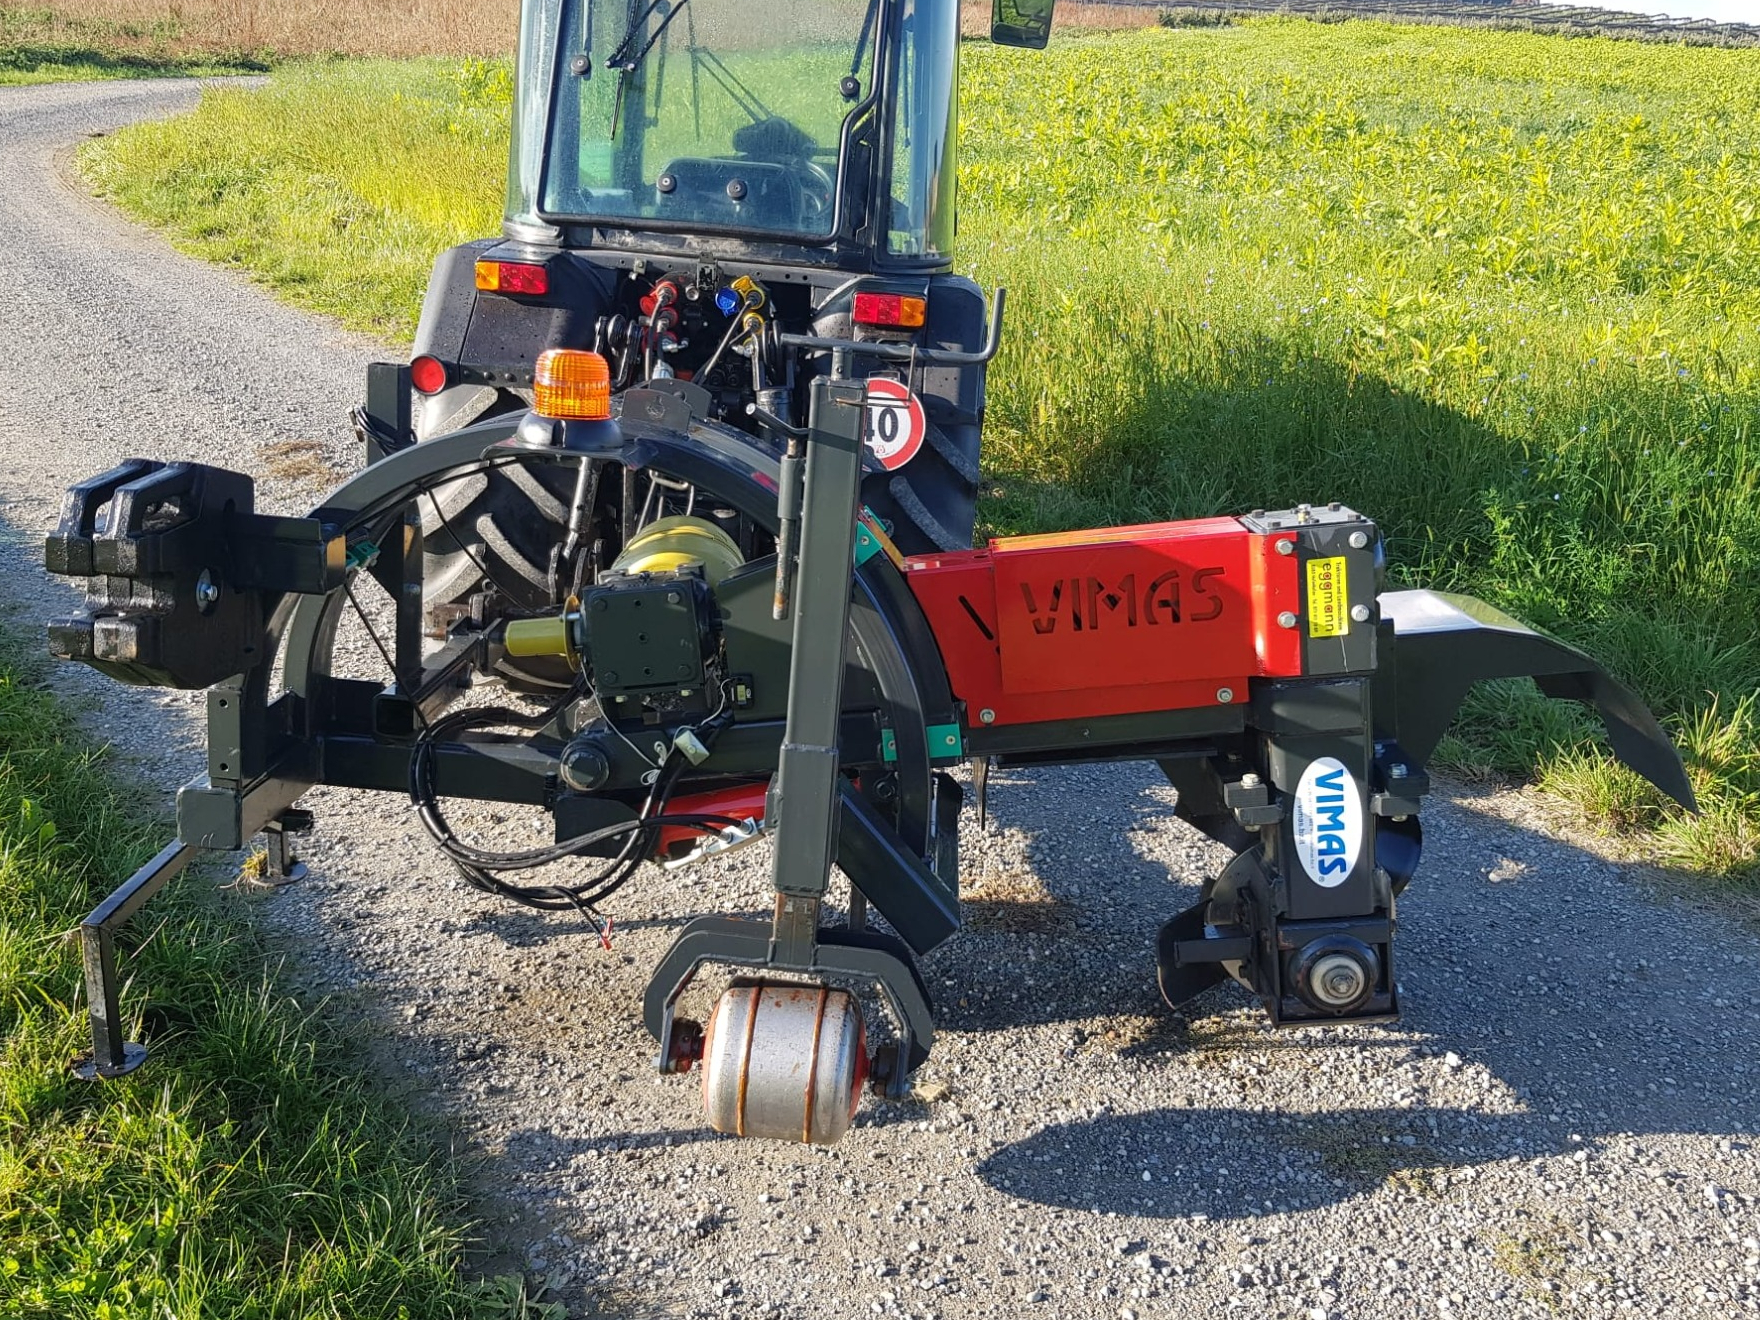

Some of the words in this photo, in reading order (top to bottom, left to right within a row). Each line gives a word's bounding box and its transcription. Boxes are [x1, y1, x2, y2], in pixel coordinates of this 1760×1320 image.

[1019, 566, 1226, 634] VIMAS
[1319, 562, 1334, 632] eggmann
[1315, 768, 1347, 876] VIMAS
